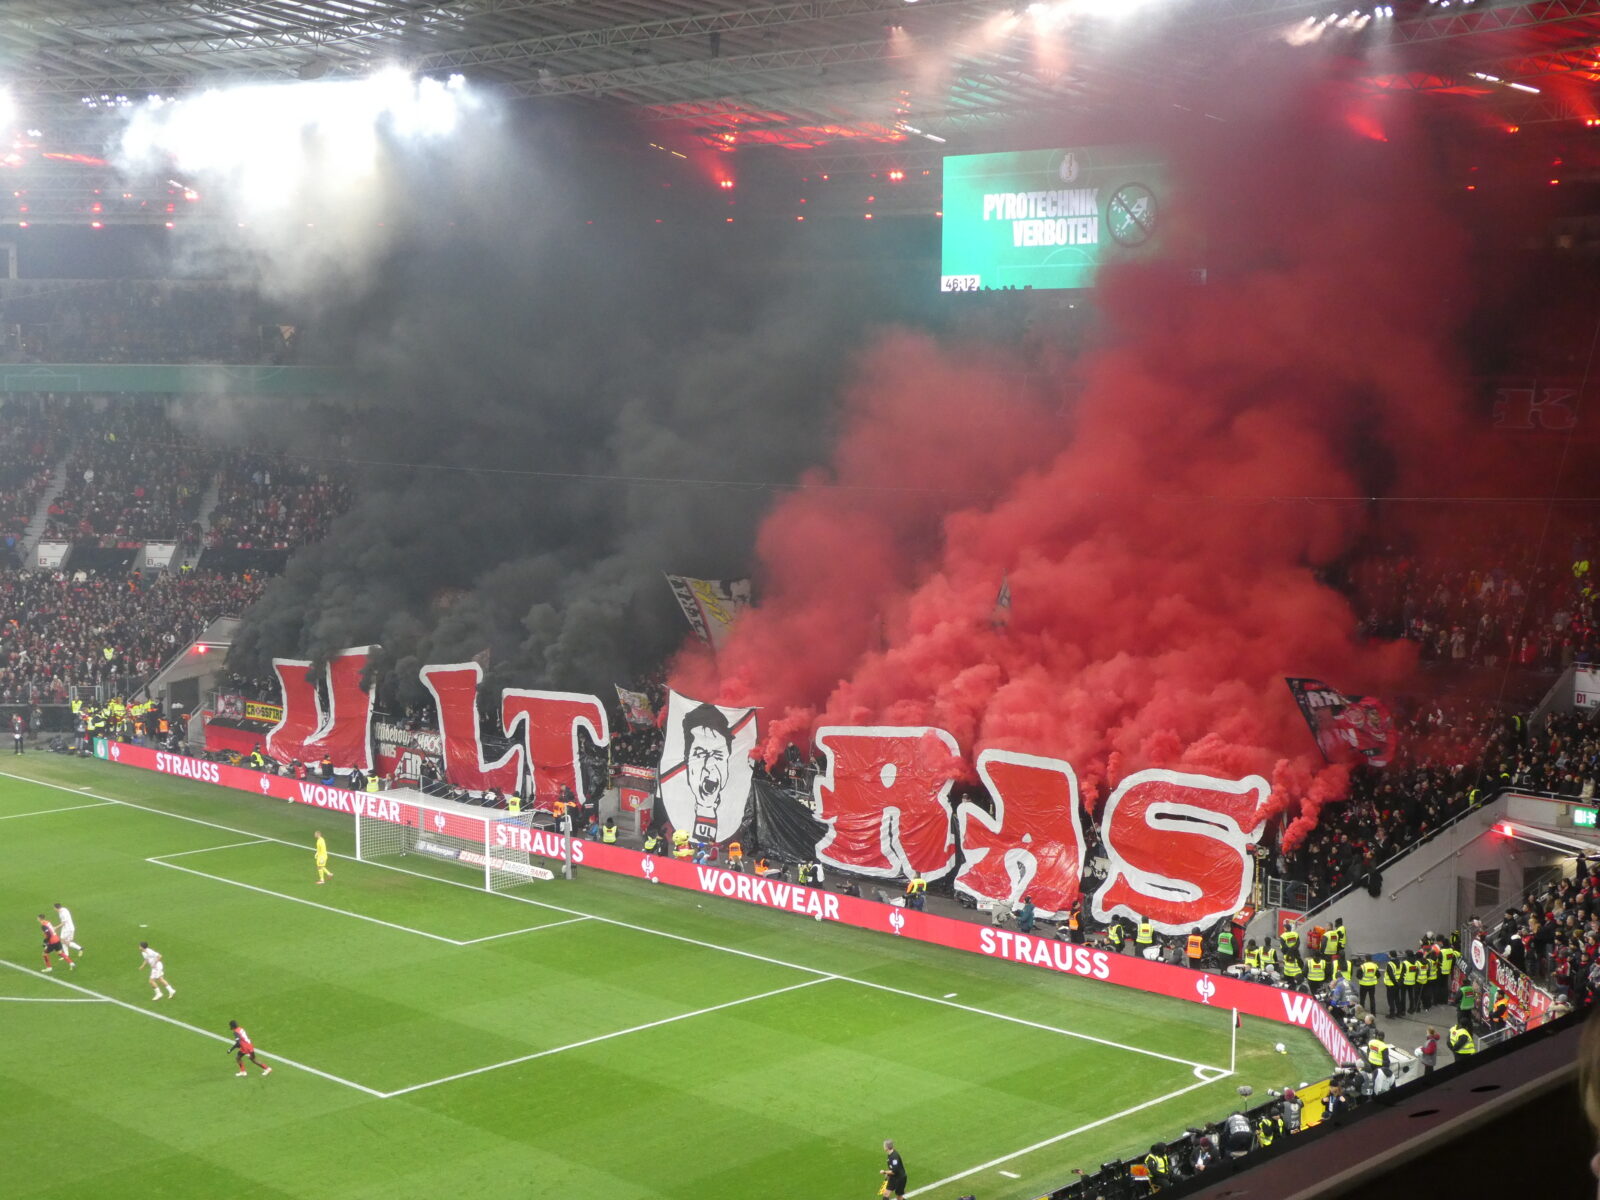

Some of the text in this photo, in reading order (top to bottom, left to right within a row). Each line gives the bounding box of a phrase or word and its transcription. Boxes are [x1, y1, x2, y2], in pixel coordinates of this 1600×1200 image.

[983, 188, 1099, 220] PYROTECHNIK
[1012, 216, 1099, 247] VERBOTEN
[945, 277, 976, 290] 46:12
[1576, 692, 1586, 705] D1
[155, 750, 220, 784] STRAUSS
[299, 781, 400, 823] WORKWEAR
[699, 824, 713, 839] UL
[697, 866, 839, 920] WORKWEAR
[980, 928, 1110, 980] STRAUSS
